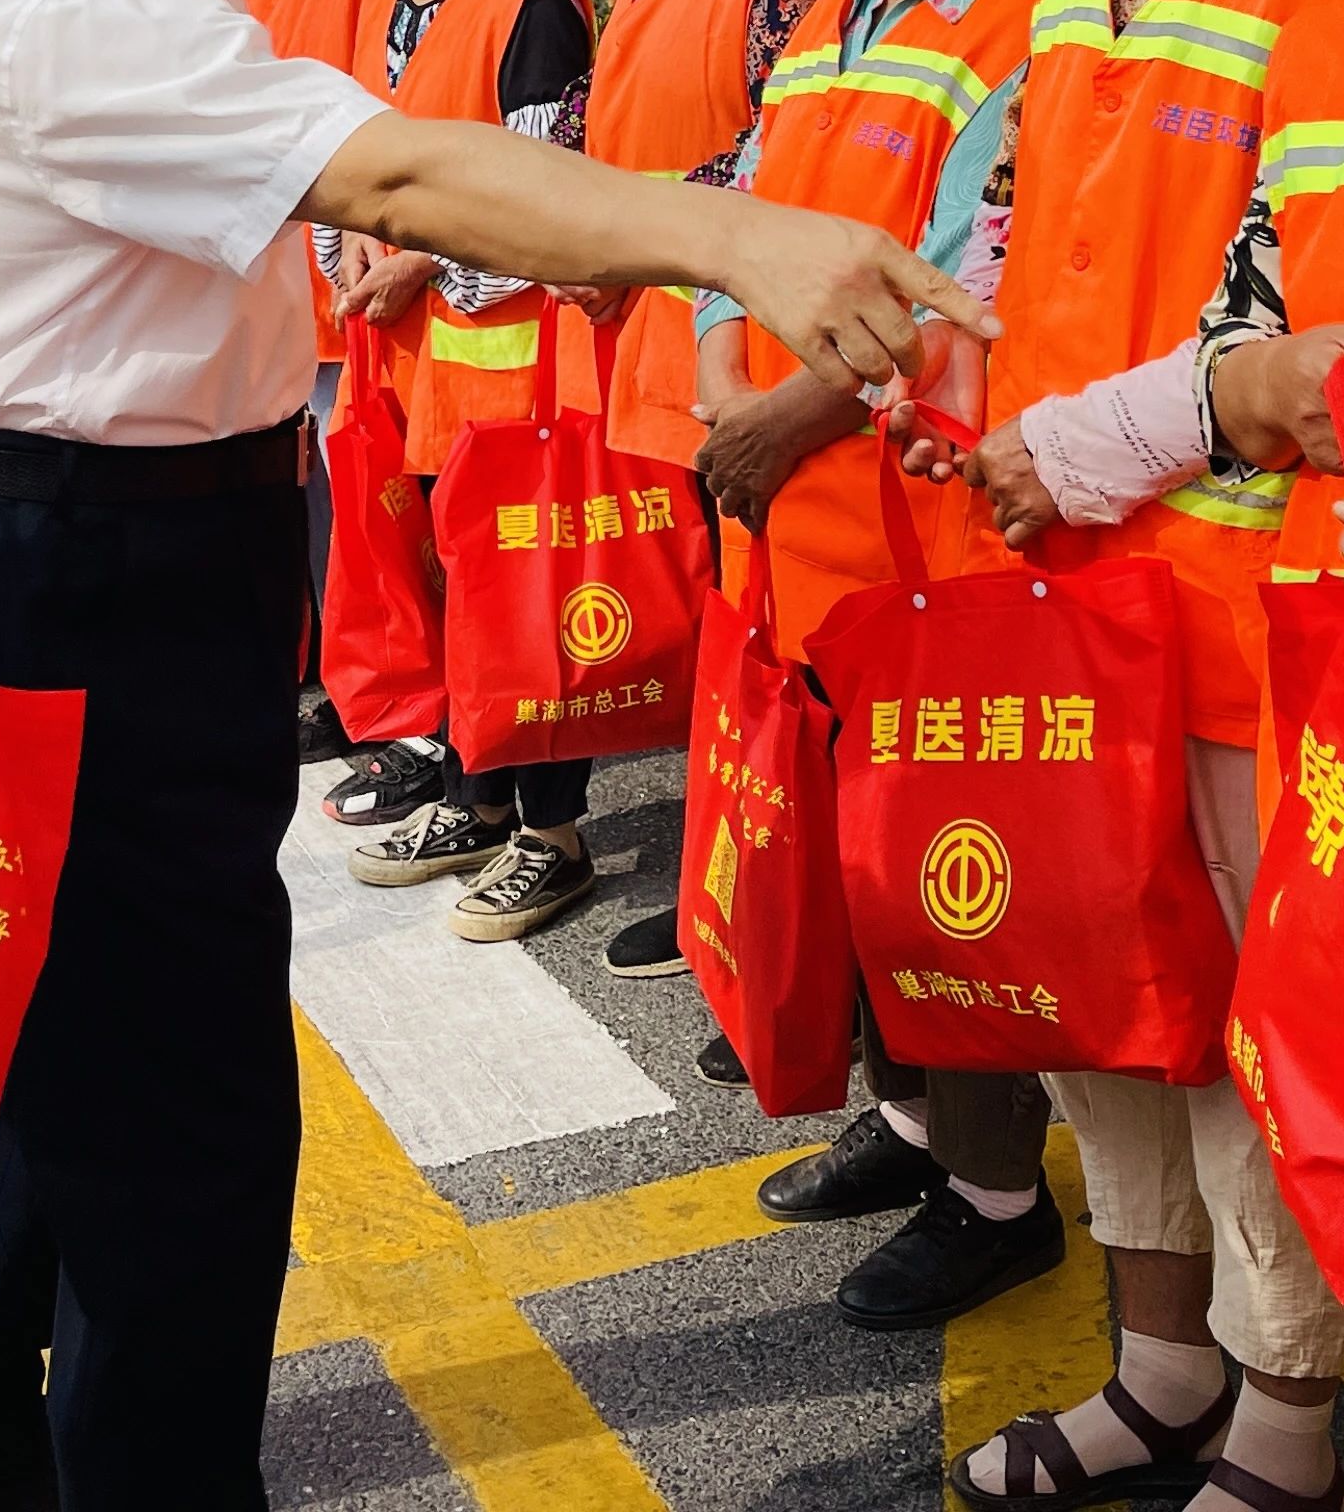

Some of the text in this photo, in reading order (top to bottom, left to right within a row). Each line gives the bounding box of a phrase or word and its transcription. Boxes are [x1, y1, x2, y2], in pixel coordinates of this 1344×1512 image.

[496, 486, 676, 552] 夏送清凉
[514, 677, 665, 726] 巢湖市总工会
[869, 694, 1097, 764] 夏送清凉
[891, 968, 1061, 1024] 巢湖市总工会
